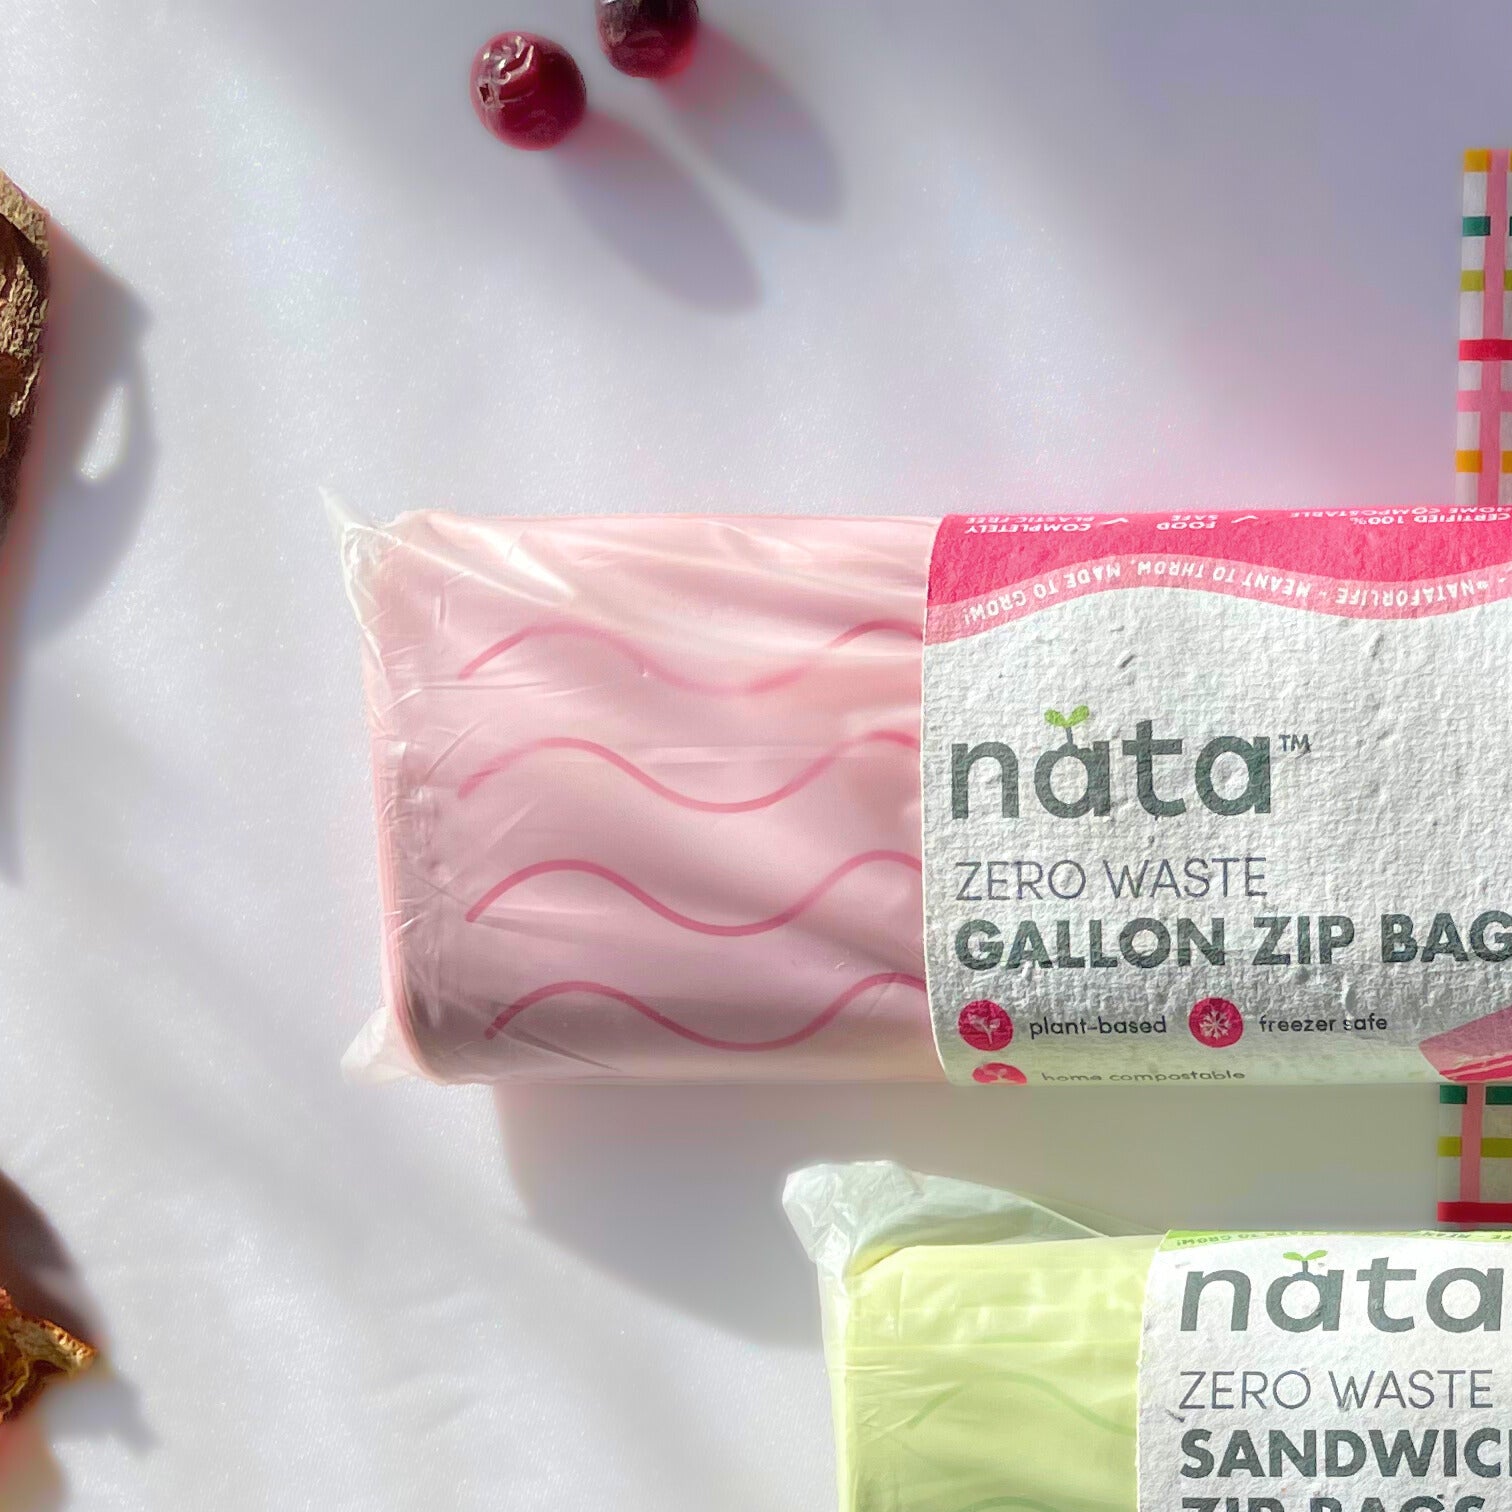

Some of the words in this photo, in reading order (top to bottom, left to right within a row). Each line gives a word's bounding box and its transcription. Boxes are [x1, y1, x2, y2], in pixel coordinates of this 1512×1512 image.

[964, 523, 1092, 534] COMPLETELY
[1156, 521, 1216, 531] FOOD
[1171, 514, 1219, 522] SAFE
[1352, 514, 1405, 525] 100%
[1414, 512, 1511, 524] CERTIFIED
[1064, 561, 1122, 590] MADE
[1211, 563, 1237, 583] TO
[1033, 576, 1060, 601] TO
[1241, 569, 1312, 600] MEANT
[961, 590, 1027, 627] GROW!
[955, 859, 1087, 901] ZERO
[1102, 856, 1268, 900] WASTE
[954, 916, 1226, 971] GALLON
[1251, 914, 1355, 966] ZIP
[1028, 1016, 1167, 1040] plant-based
[1258, 1015, 1337, 1033] freezer
[1342, 1012, 1389, 1032] safe
[1041, 1071, 1102, 1082] home
[1109, 1070, 1246, 1083] compostable
[1179, 1369, 1312, 1411] ZERO
[1328, 1369, 1494, 1411] WASTE
